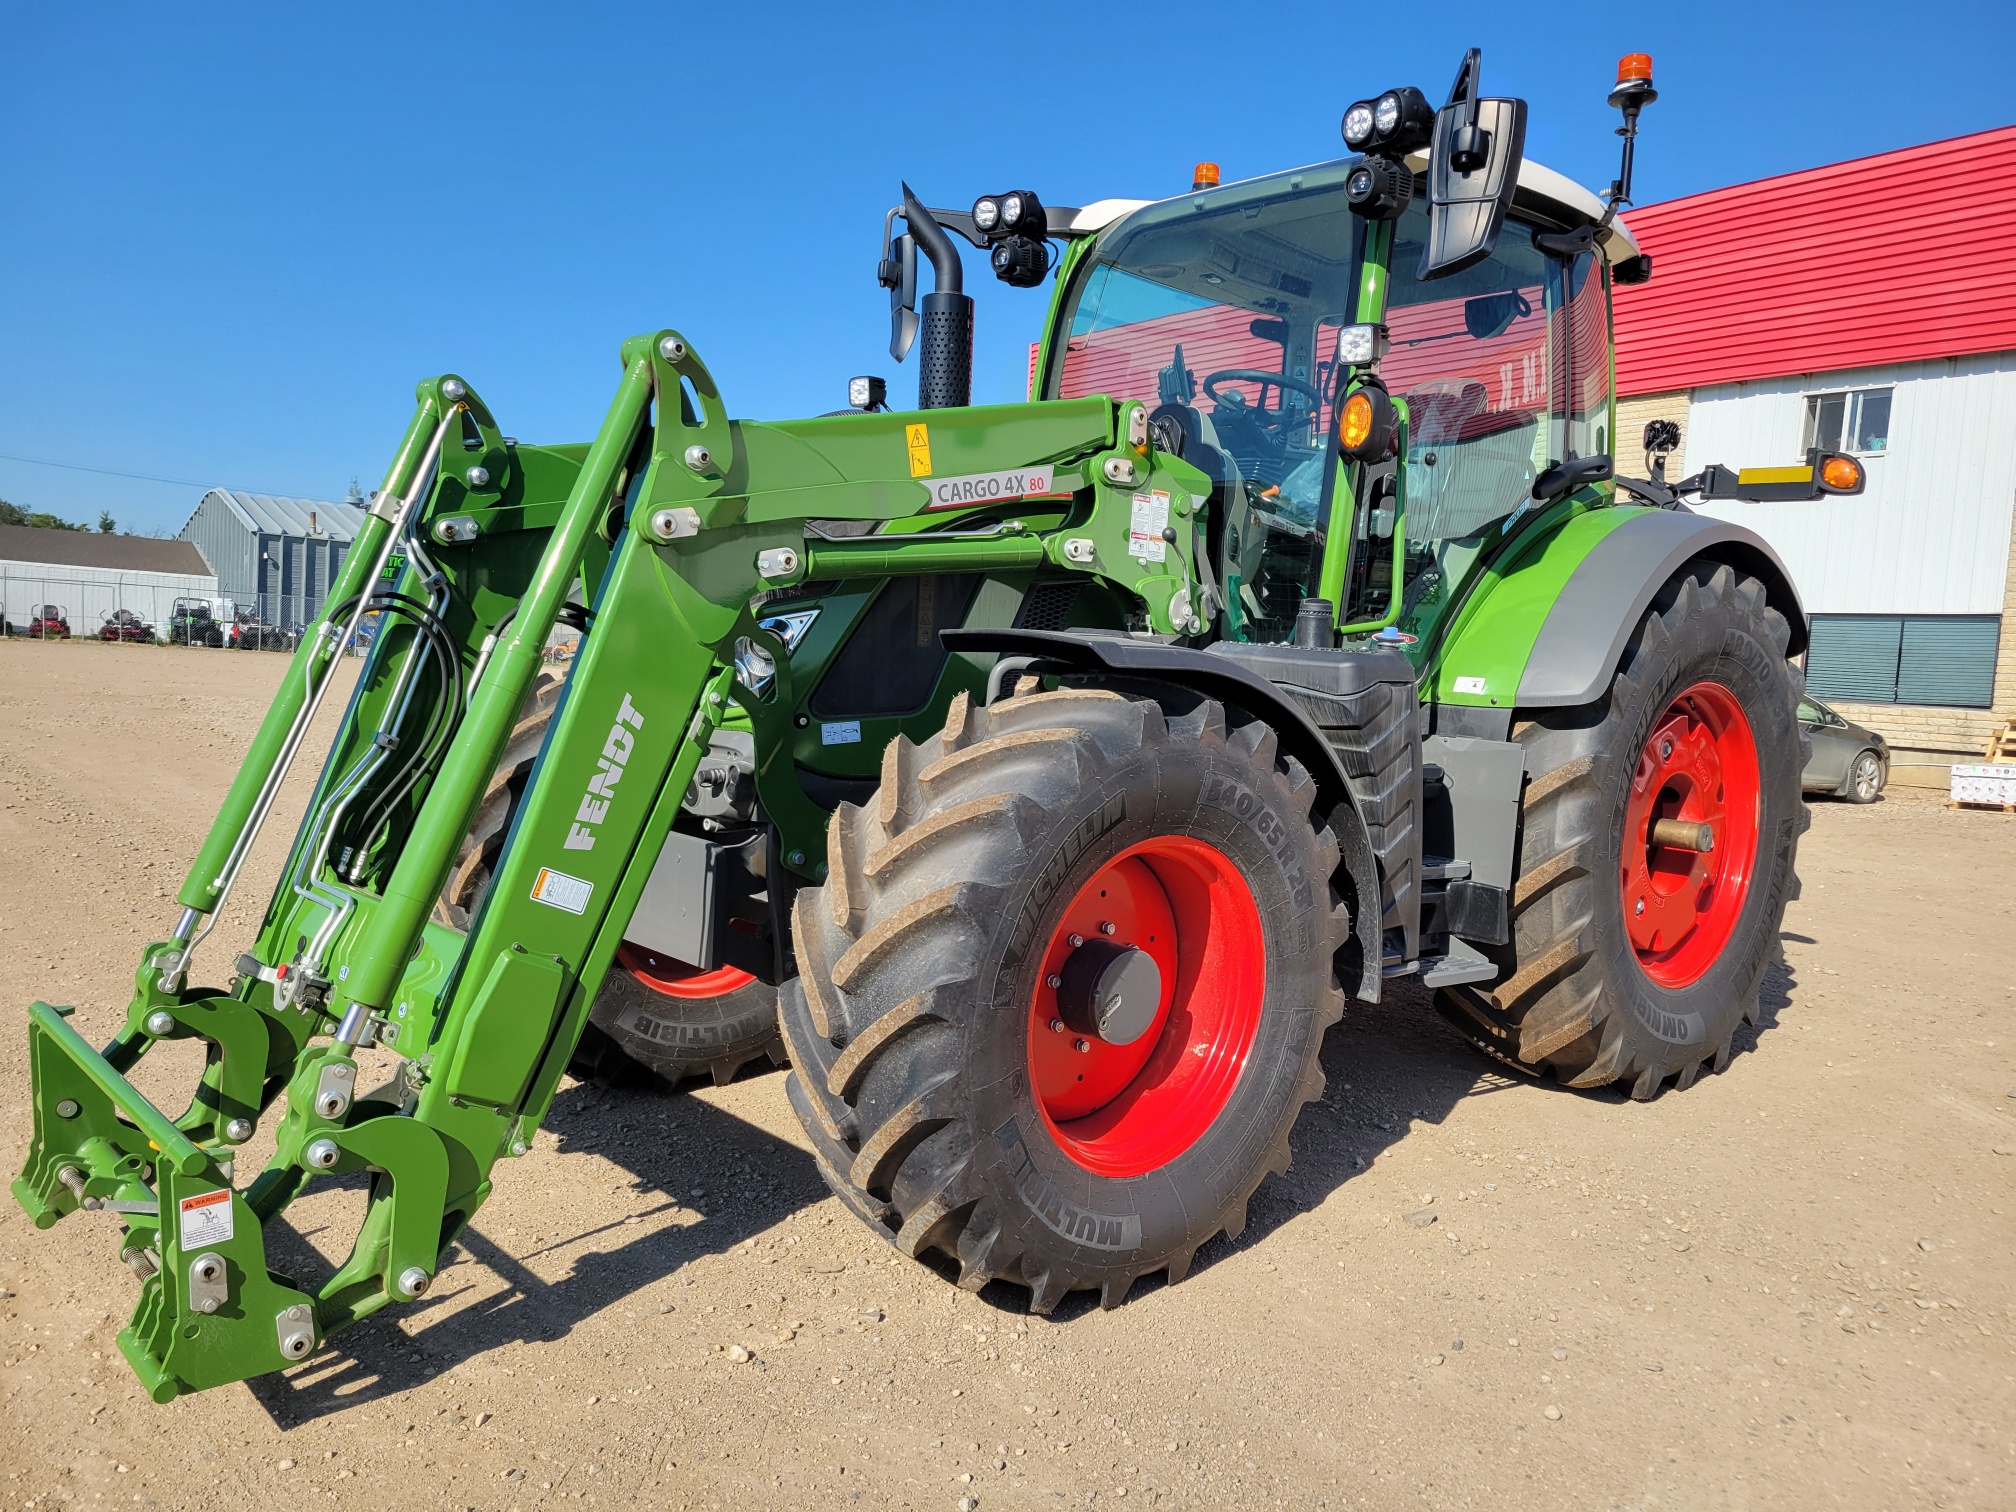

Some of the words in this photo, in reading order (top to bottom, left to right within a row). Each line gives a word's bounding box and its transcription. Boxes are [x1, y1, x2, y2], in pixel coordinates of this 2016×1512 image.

[937, 478, 999, 503] CARGO
[1004, 474, 1026, 494] 4X
[1029, 476, 1045, 492] 80
[381, 567, 396, 578] AT
[563, 691, 645, 851] FENDT
[1010, 792, 1124, 957] MICHELIN
[634, 1014, 764, 1045] MULTIBIB
[194, 1193, 228, 1206] WARNING
[1007, 1140, 1123, 1246] MULTIBIB
